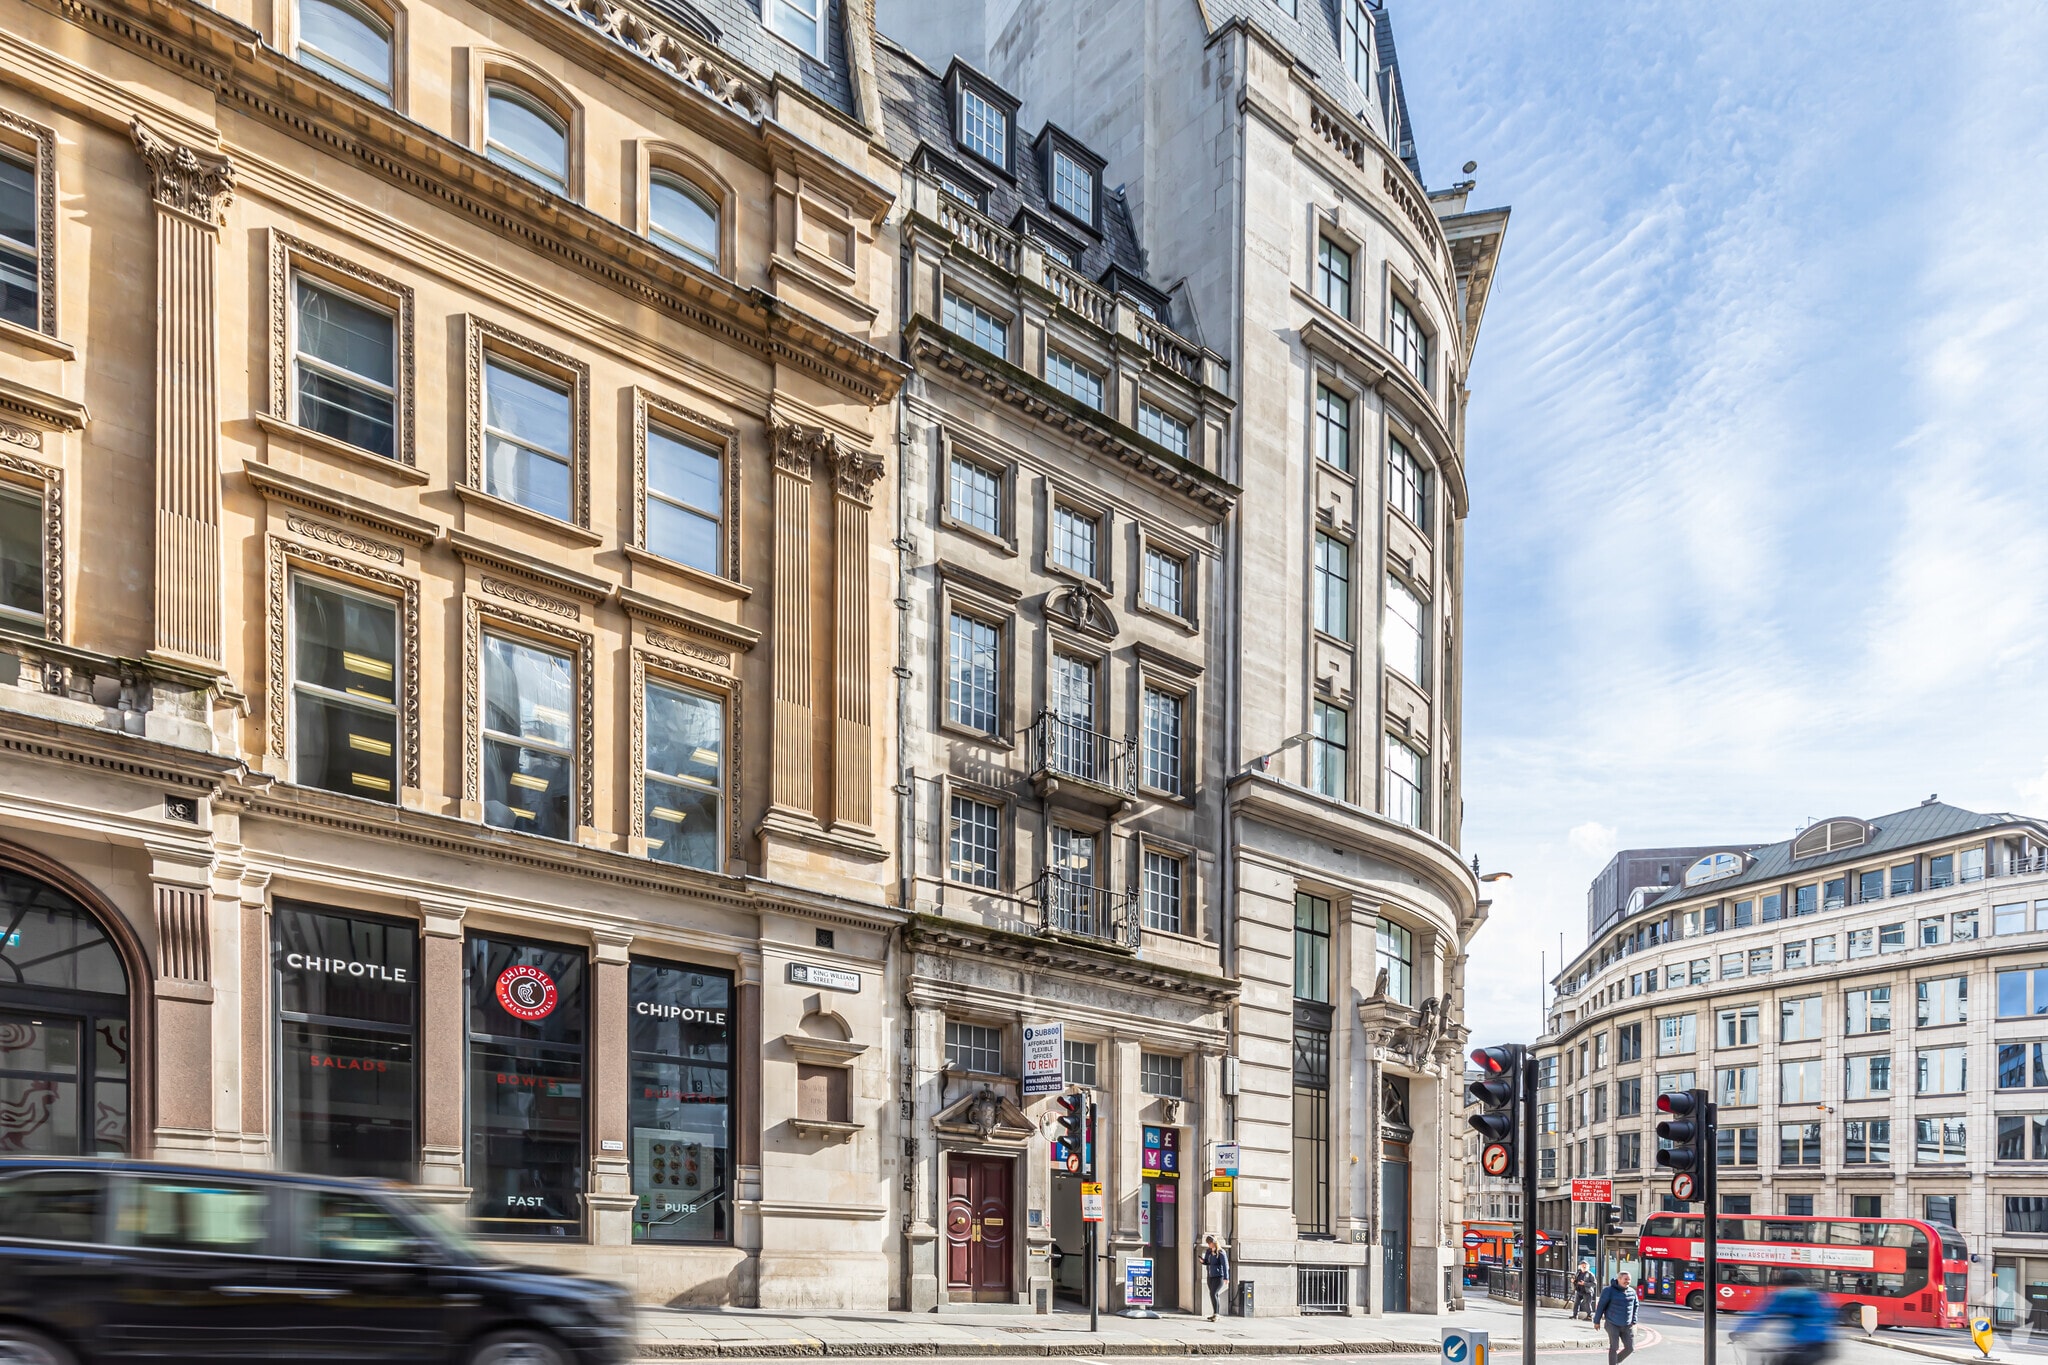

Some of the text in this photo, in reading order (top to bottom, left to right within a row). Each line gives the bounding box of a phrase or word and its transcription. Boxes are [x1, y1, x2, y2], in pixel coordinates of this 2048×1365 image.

[287, 953, 407, 983] CHIPOTLE
[500, 967, 555, 991] CHIPOTLE
[814, 976, 833, 984] STREET
[830, 973, 855, 982] WILLIAM
[501, 993, 554, 1016] MEXICAN GRILL
[636, 1002, 726, 1025] CHIPOTLE
[1035, 1028, 1059, 1036] SUB800
[1028, 1039, 1057, 1047] AFFORDABLE
[310, 1055, 387, 1072] SALADS
[1028, 1059, 1058, 1070] TO RENT
[496, 1073, 557, 1089] BOWLS
[1026, 1076, 1061, 1084] www.sub800.com
[1225, 1152, 1234, 1160] BFC
[507, 1196, 544, 1207] FAST
[664, 1203, 697, 1213] PURE
[1030, 1212, 1040, 1222] 69
[1355, 1232, 1366, 1241] 68
